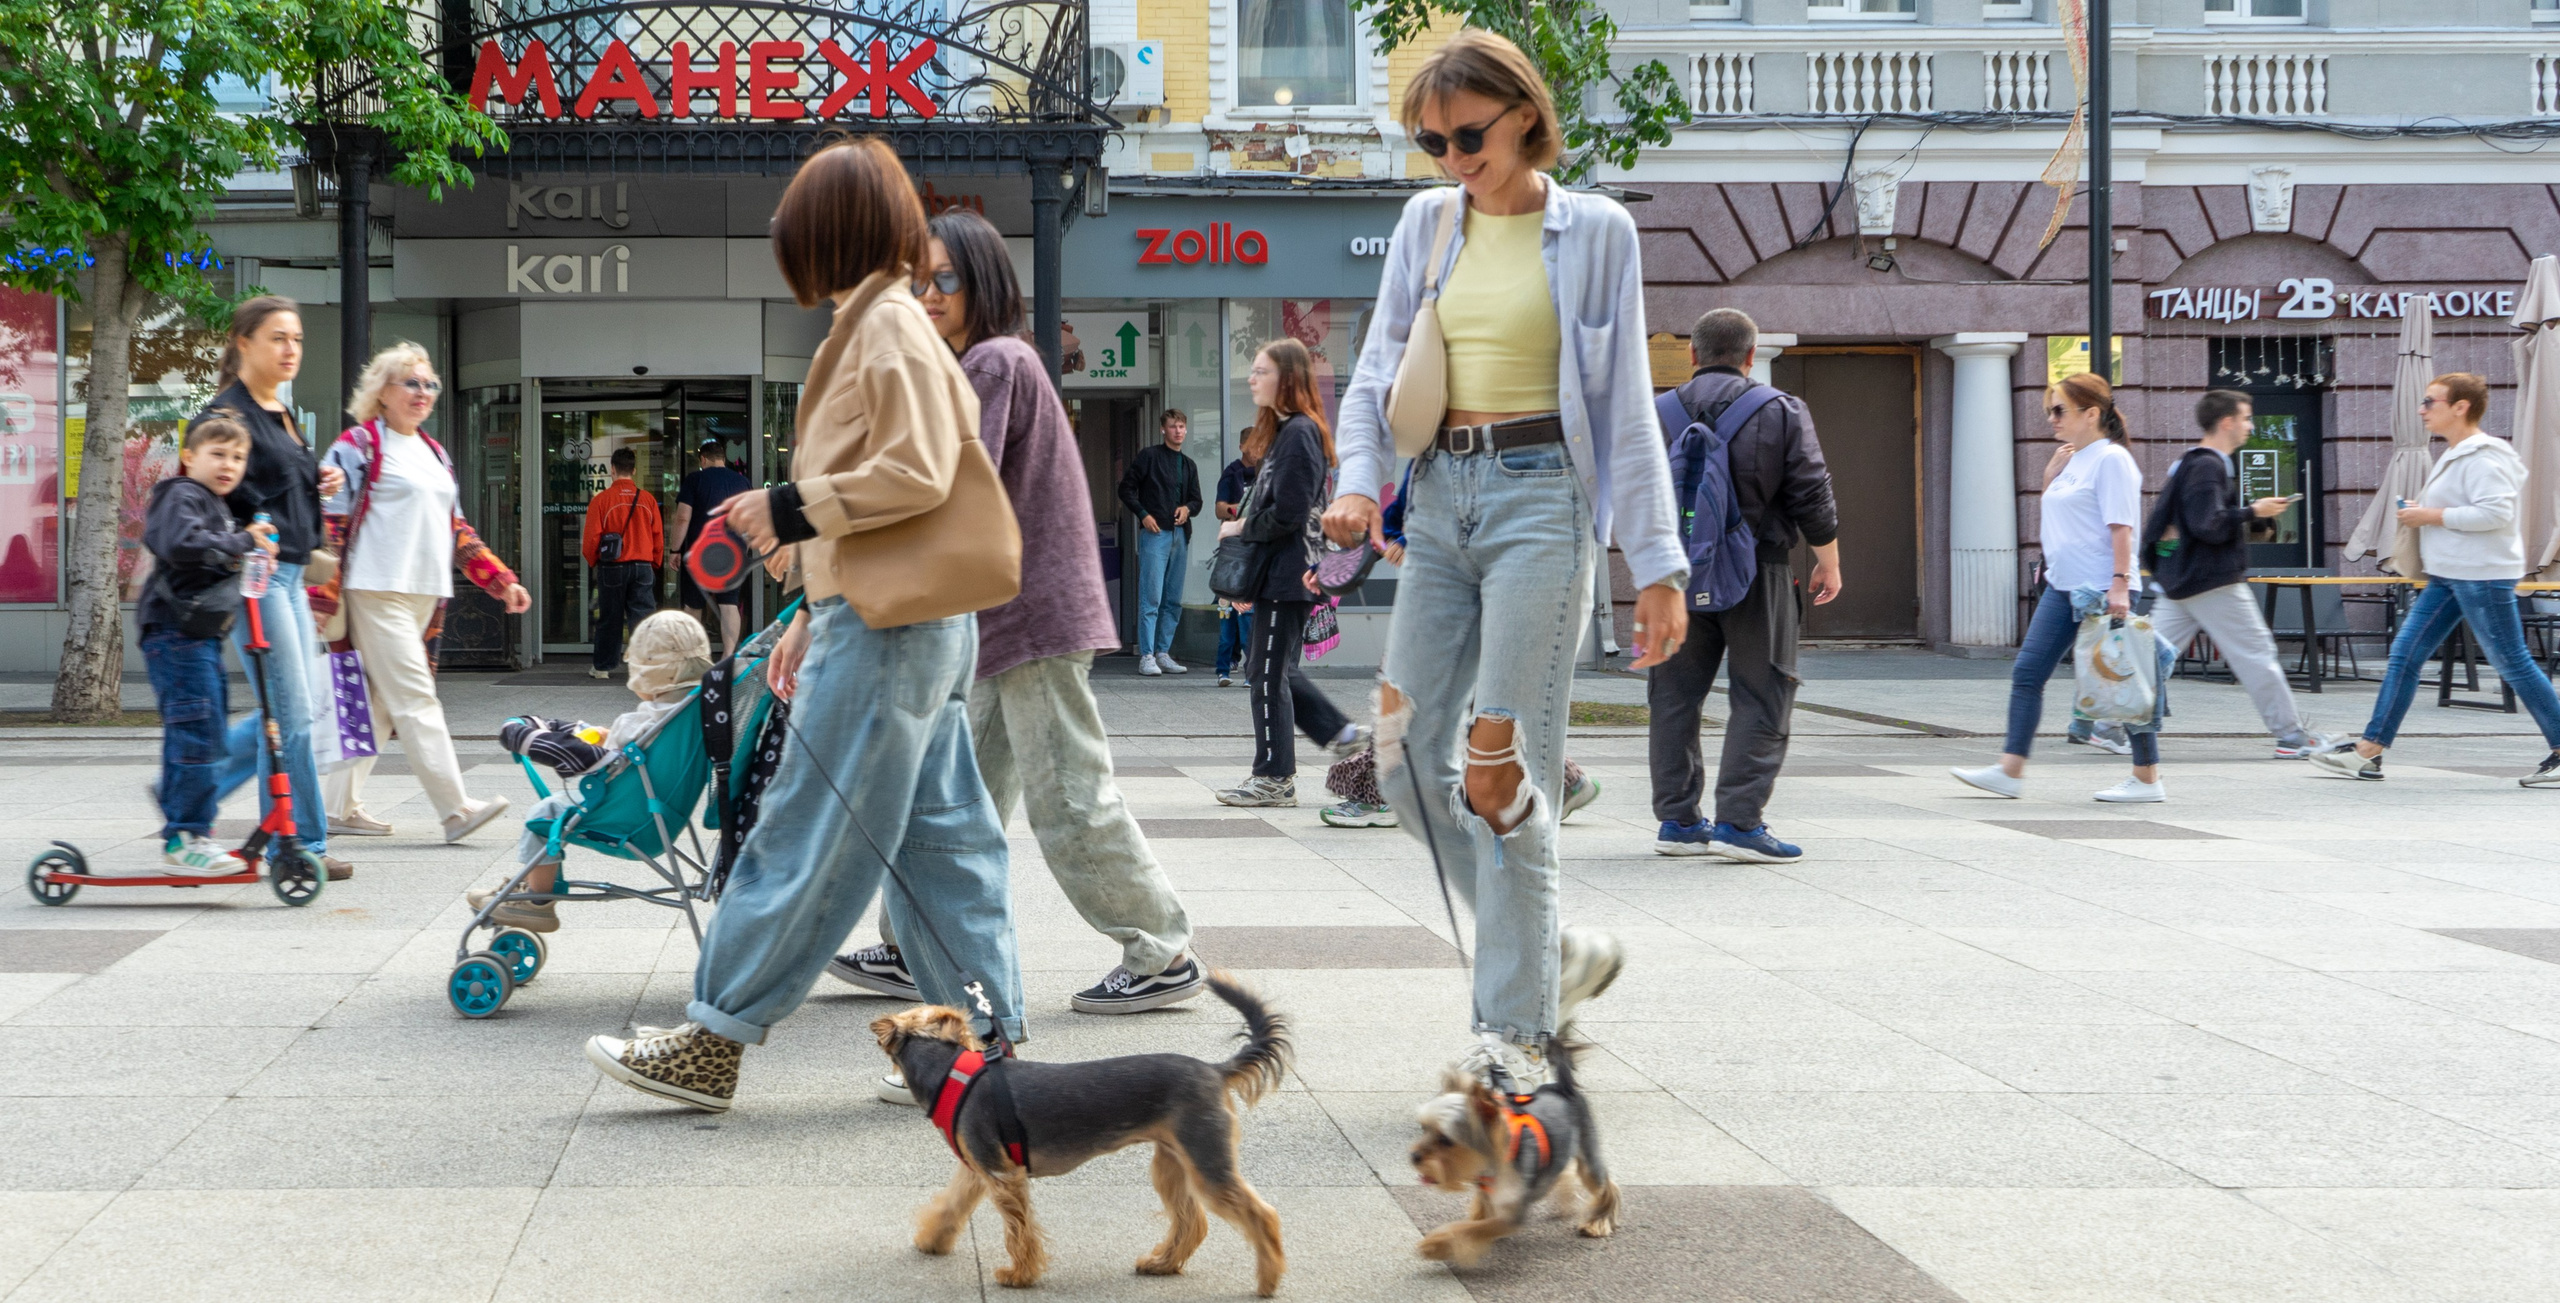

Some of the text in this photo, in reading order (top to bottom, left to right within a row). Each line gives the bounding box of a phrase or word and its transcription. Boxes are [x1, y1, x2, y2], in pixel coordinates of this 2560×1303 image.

[470, 39, 937, 120] МАНЕЖ
[1136, 222, 1269, 264] zolla
[507, 244, 630, 293] kari
[2149, 287, 2261, 324] ТАНЦЫ
[1089, 368, 1128, 379] этаж
[1101, 348, 1116, 367] 3
